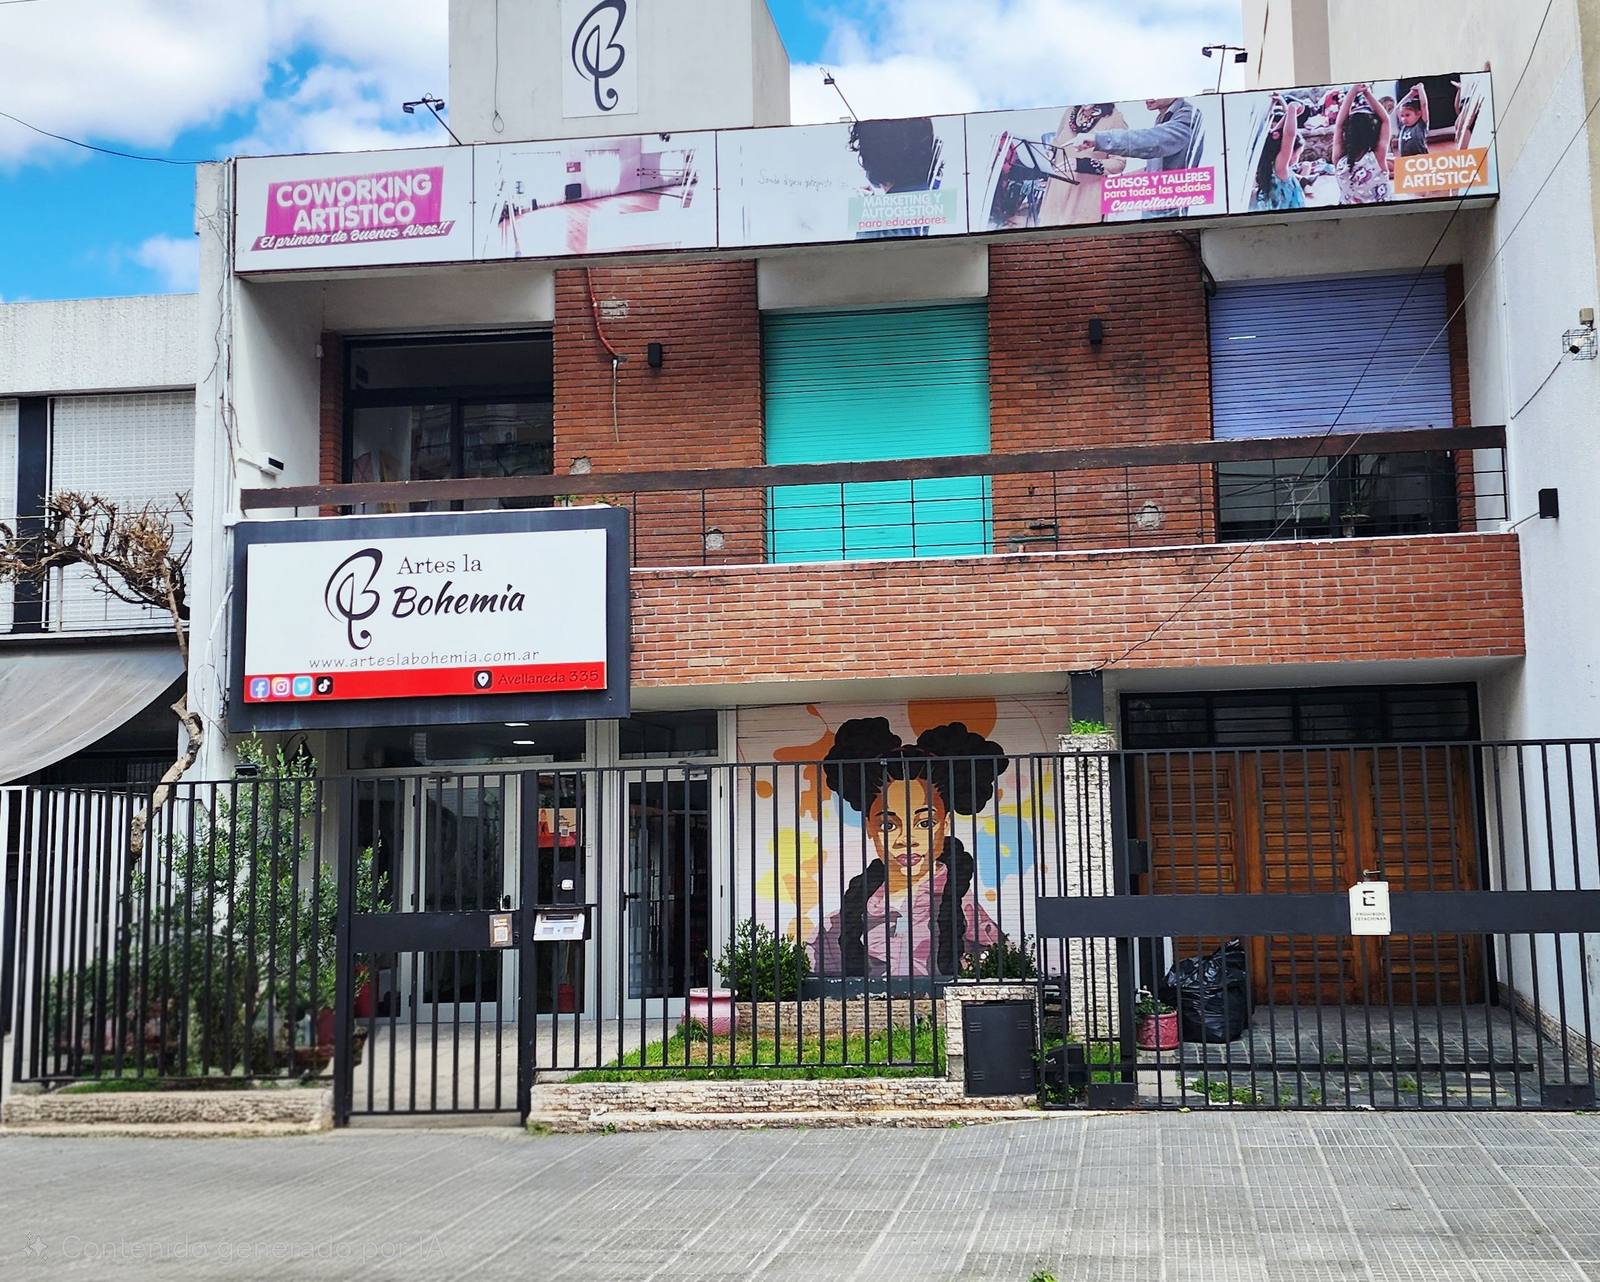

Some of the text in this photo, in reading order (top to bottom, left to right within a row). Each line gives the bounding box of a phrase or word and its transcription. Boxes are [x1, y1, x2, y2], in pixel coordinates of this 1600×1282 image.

[1404, 154, 1477, 173] COLONIA
[1104, 171, 1211, 189] CURSOS Y TALLERES
[1402, 169, 1481, 189] ARTÍSTICA
[276, 173, 432, 207] COWORKING
[1103, 190, 1126, 201] para
[1159, 185, 1173, 195] las
[1175, 182, 1212, 193] edades
[863, 192, 942, 208] MARKETING Y
[1110, 194, 1206, 212] Capacitaciones
[293, 200, 416, 233] ARTÍSTICO
[858, 215, 946, 229] para educadores
[260, 221, 448, 250] El primero de Buenos Aires!!
[396, 553, 483, 576] Artes la
[391, 580, 526, 619] Bohemia
[308, 648, 540, 669] www.arteslabohemia.com.ar
[497, 669, 600, 686] Avellaneda 335
